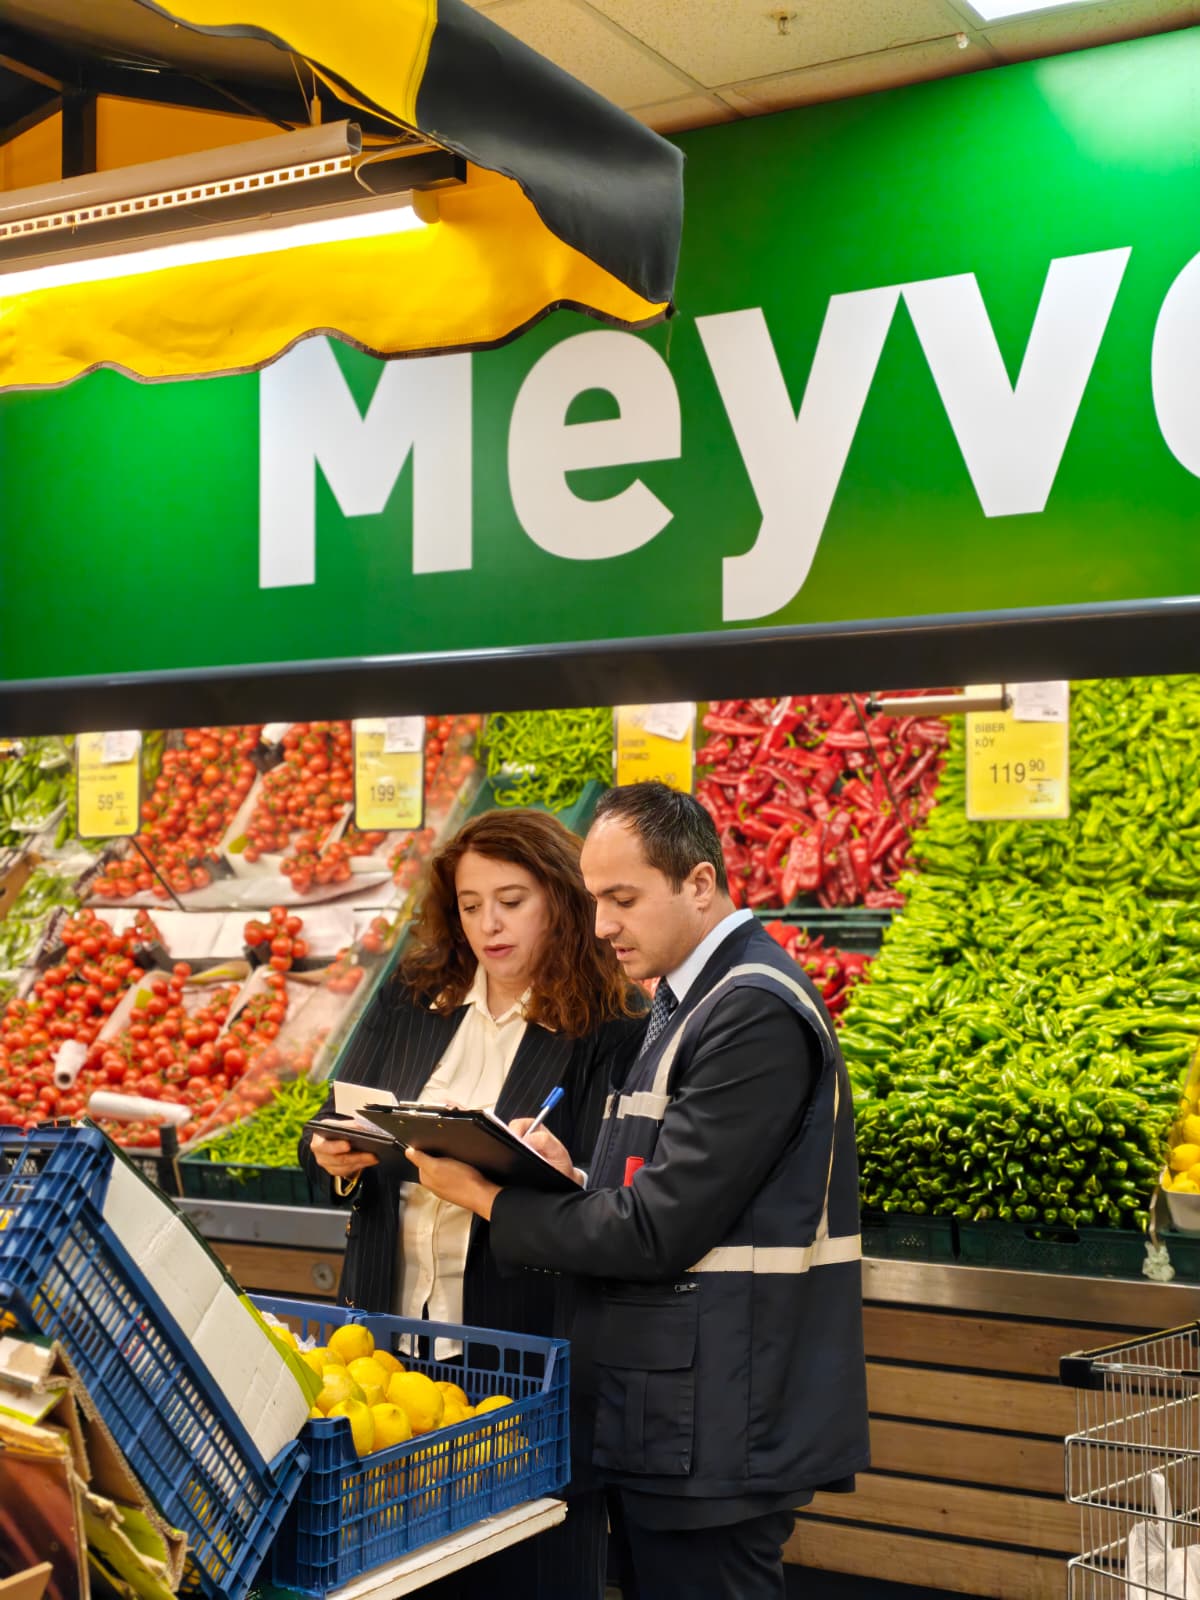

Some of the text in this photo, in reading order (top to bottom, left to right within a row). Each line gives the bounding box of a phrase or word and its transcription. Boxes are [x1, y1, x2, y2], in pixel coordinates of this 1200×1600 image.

[259, 246, 1200, 622] Meyv
[990, 758, 1045, 784] 119 90
[98, 794, 113, 811] 59
[370, 785, 396, 802] 199
